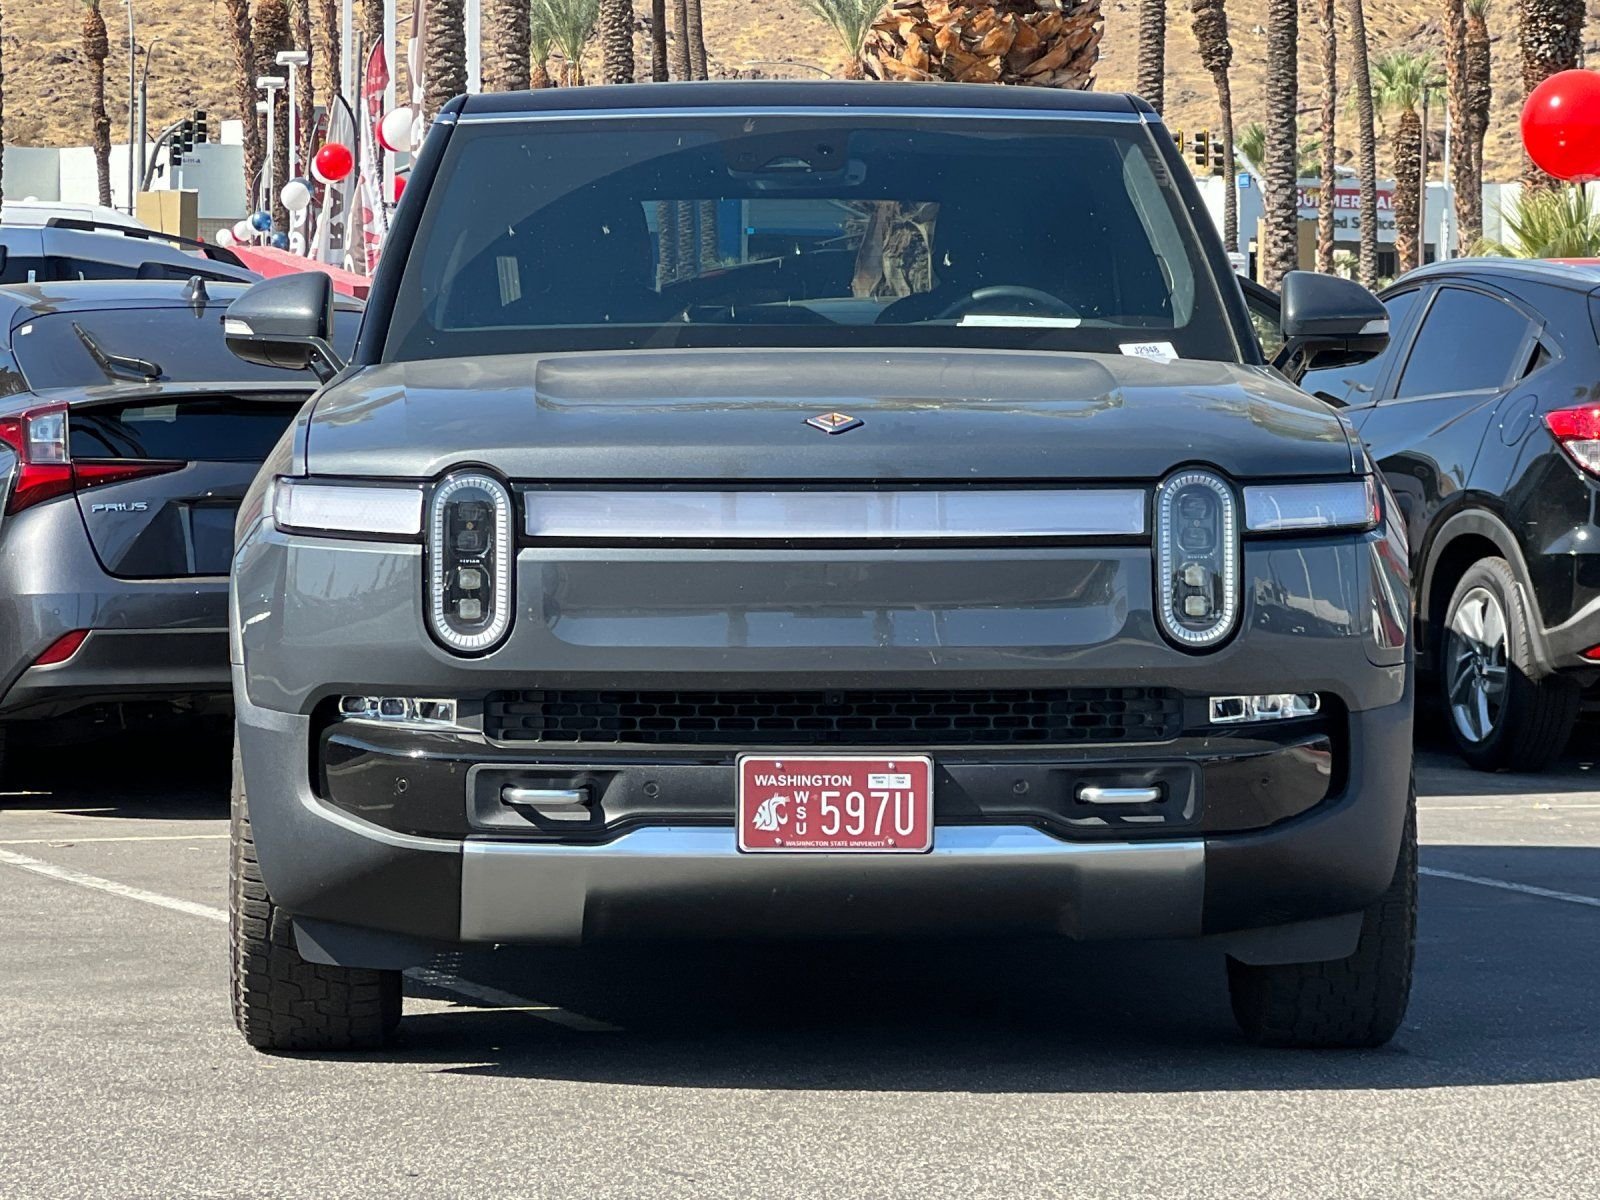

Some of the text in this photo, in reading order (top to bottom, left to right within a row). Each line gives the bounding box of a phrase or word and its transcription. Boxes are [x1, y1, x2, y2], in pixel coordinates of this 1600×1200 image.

[91, 502, 148, 513] PRIUS
[754, 775, 852, 787] WASHINGTON
[821, 791, 914, 836] 597U
